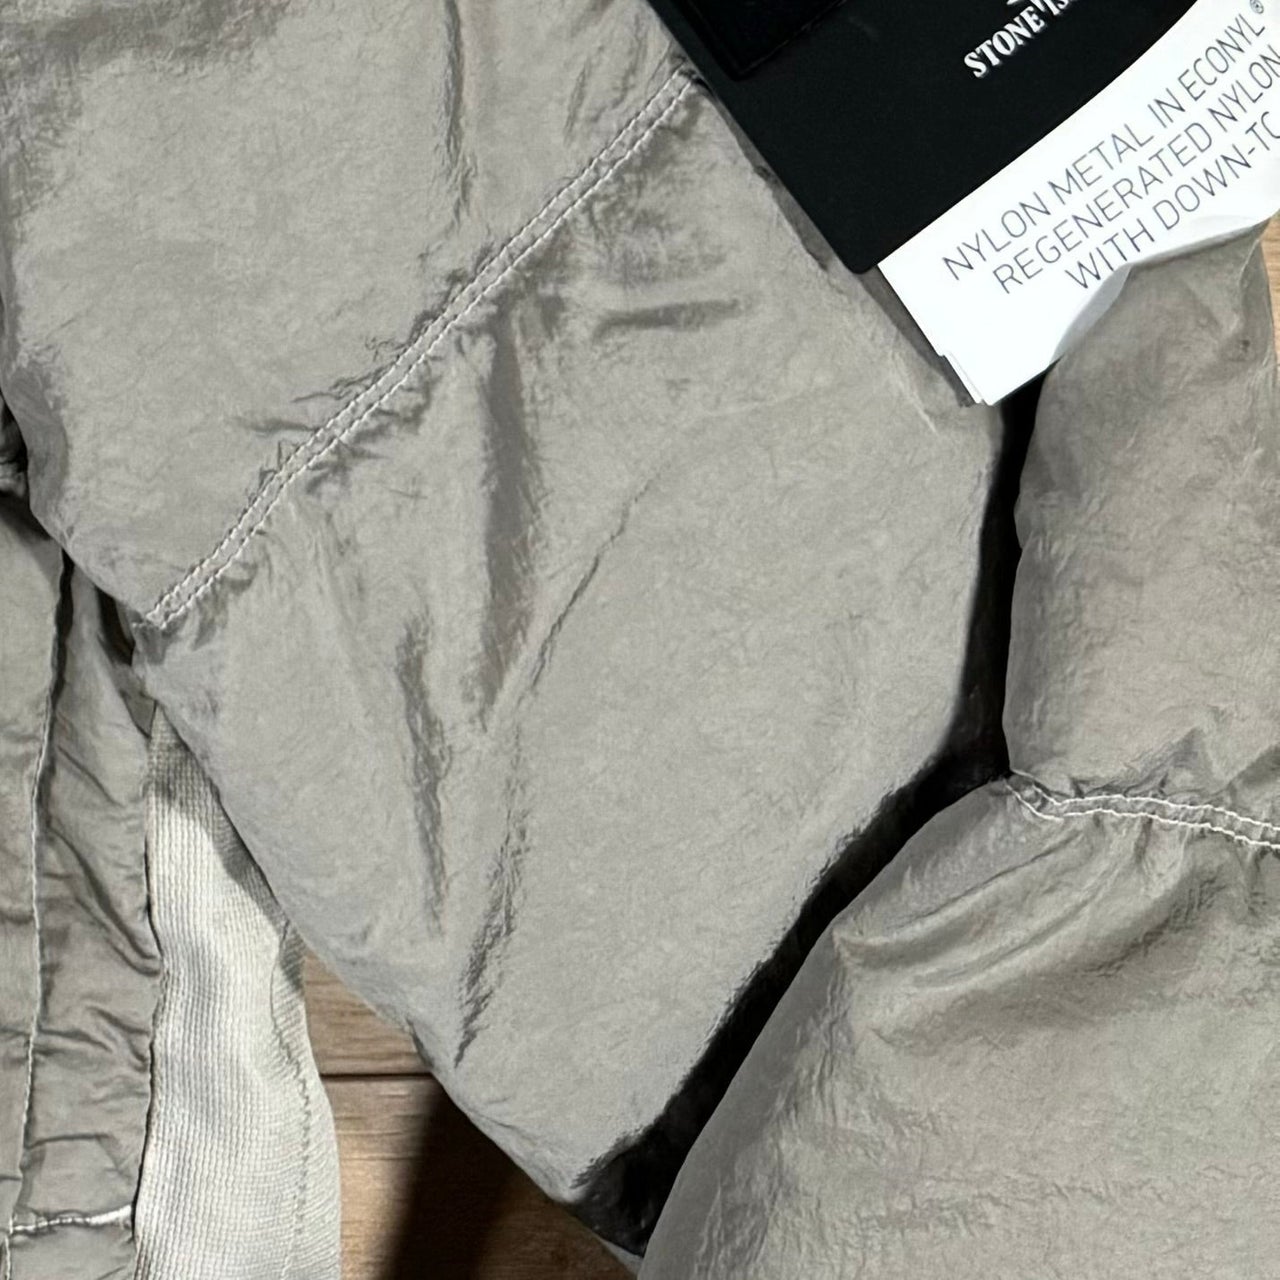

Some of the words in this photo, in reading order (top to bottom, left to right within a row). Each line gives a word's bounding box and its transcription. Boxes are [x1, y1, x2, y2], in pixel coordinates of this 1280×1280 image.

[963, 5, 1046, 79] STONE
[942, 192, 1051, 281] NYLON
[1048, 124, 1155, 205] METAL
[1147, 87, 1186, 129] IN
[992, 122, 1213, 294] REGENERATED
[1064, 218, 1155, 290] WITH
